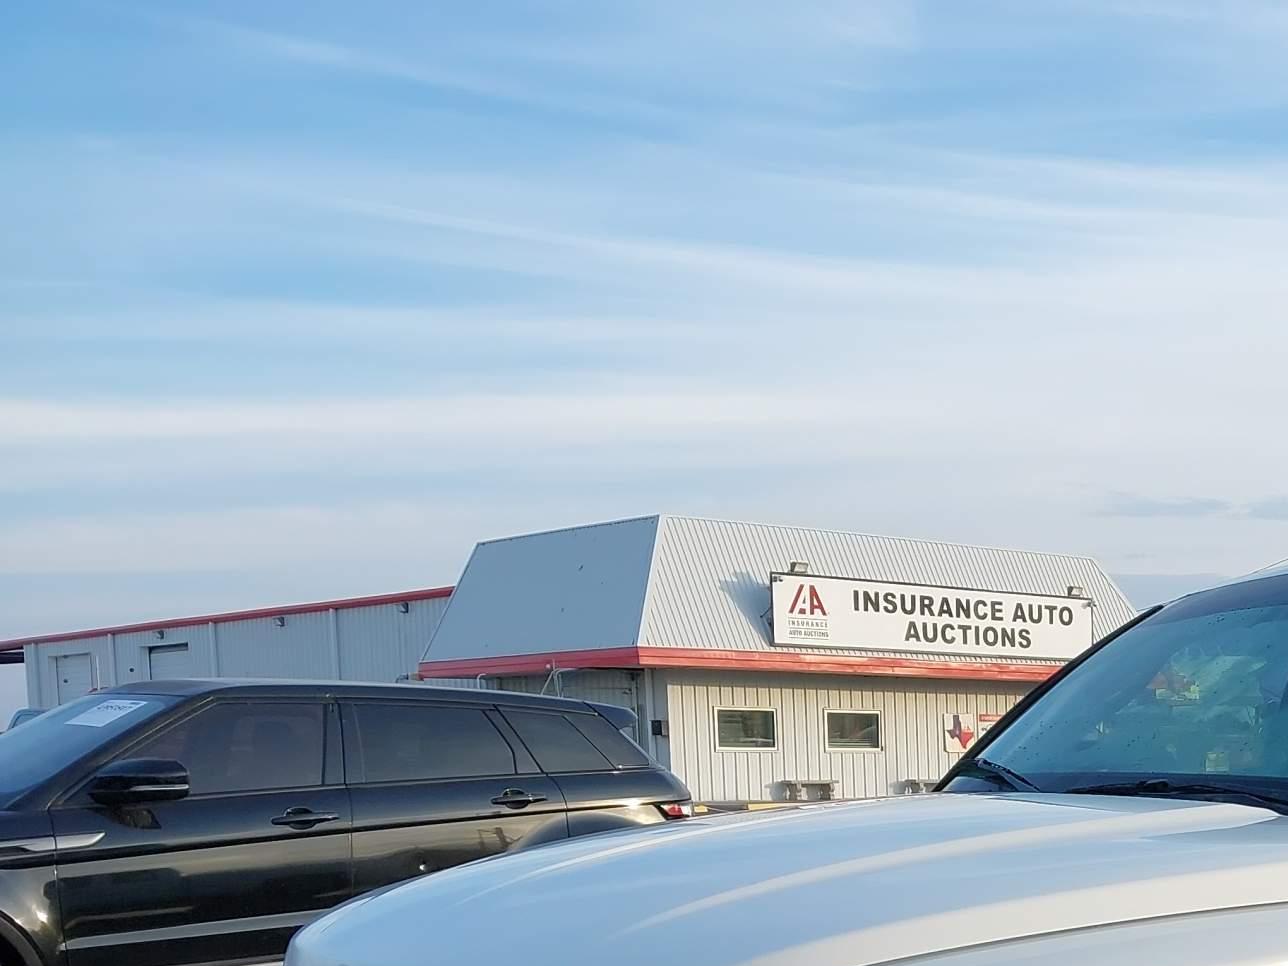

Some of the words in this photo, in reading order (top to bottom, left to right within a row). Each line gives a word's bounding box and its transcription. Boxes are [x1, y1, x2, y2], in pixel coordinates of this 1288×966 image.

[853, 589, 1004, 622] INSURANCE
[1012, 601, 1074, 627] AUTO
[788, 619, 829, 629] INSURANCE
[789, 629, 803, 637] AUTO
[804, 630, 829, 639] AUCTIONS
[904, 620, 1032, 649] AUCTIONS
